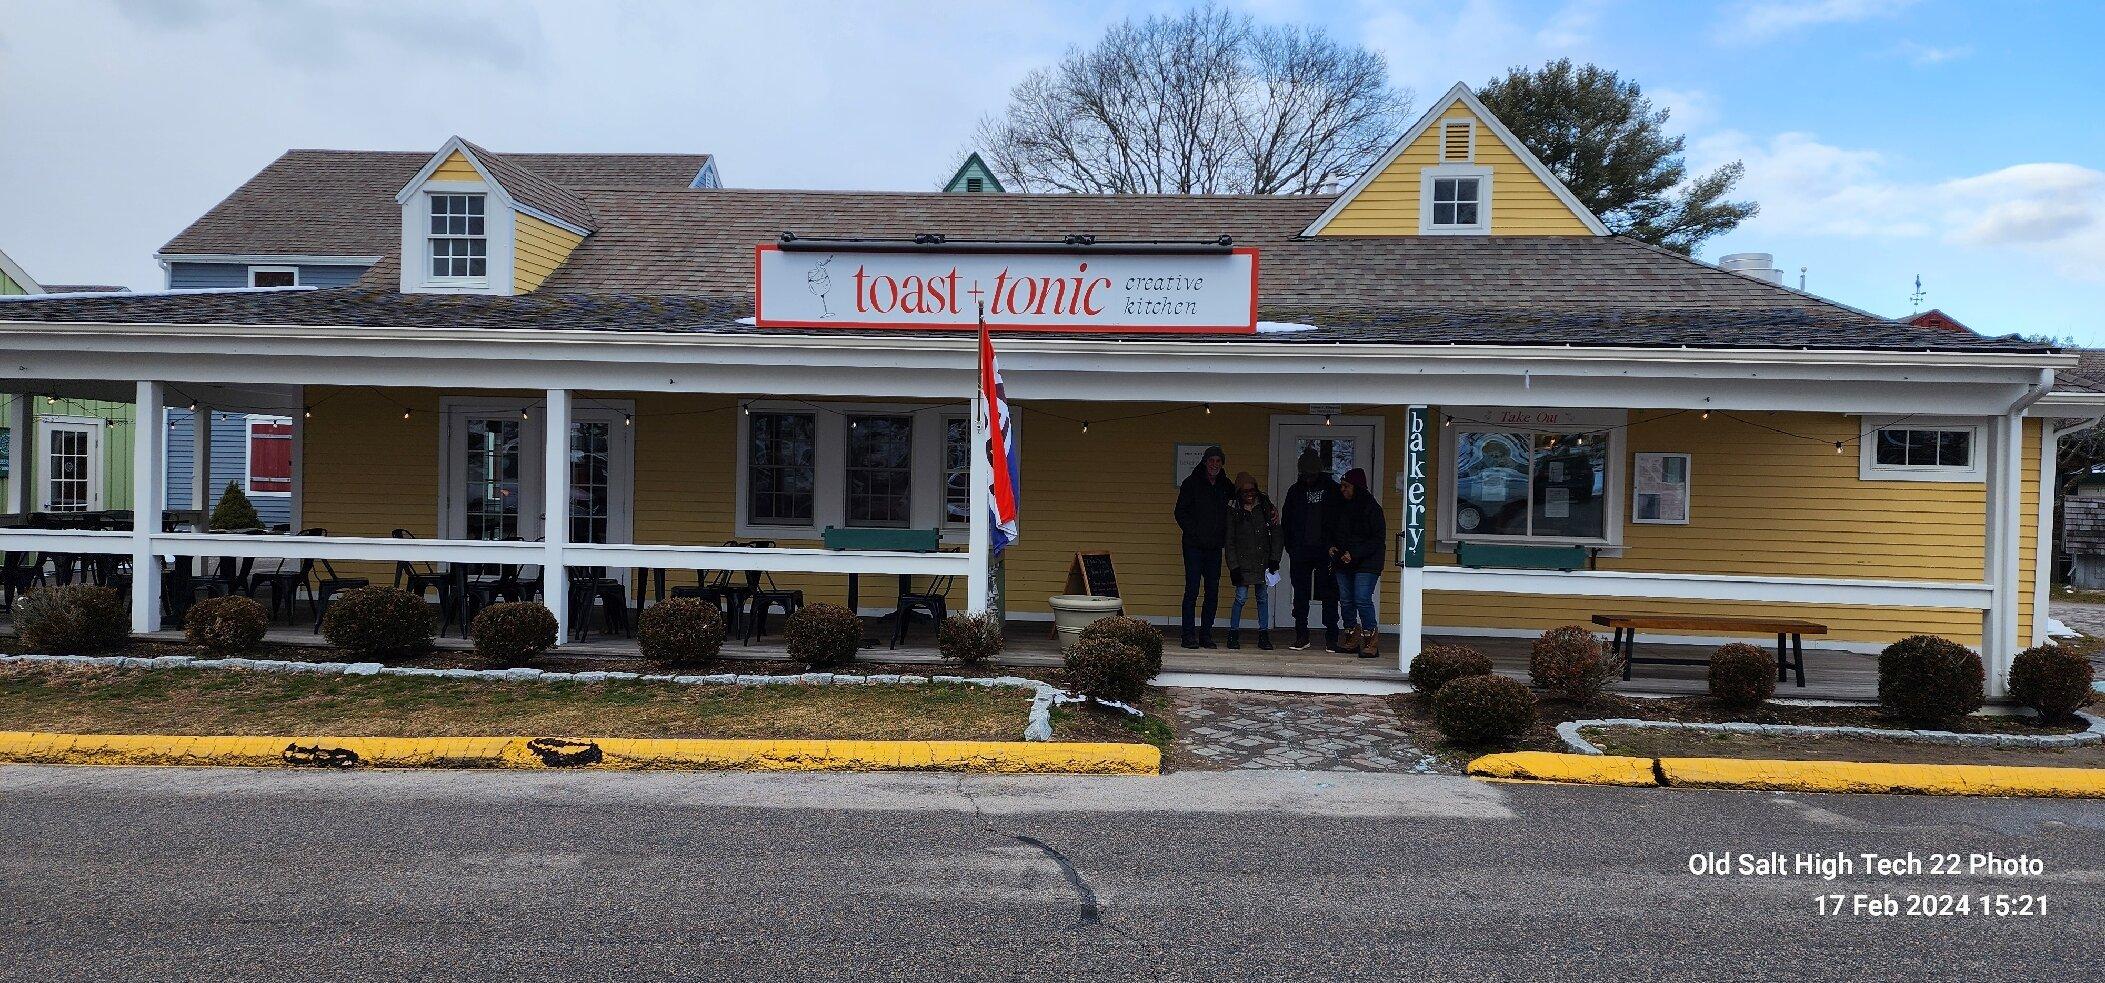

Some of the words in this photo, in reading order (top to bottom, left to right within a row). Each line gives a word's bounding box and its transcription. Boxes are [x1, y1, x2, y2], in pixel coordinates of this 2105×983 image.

[852, 264, 964, 314] toast
[991, 262, 1112, 316] tonic
[1125, 274, 1204, 291] creative
[1123, 296, 1198, 315] kitchen
[1502, 411, 1531, 423] Take
[1536, 411, 1558, 423] Out
[1408, 411, 1426, 552] bakery
